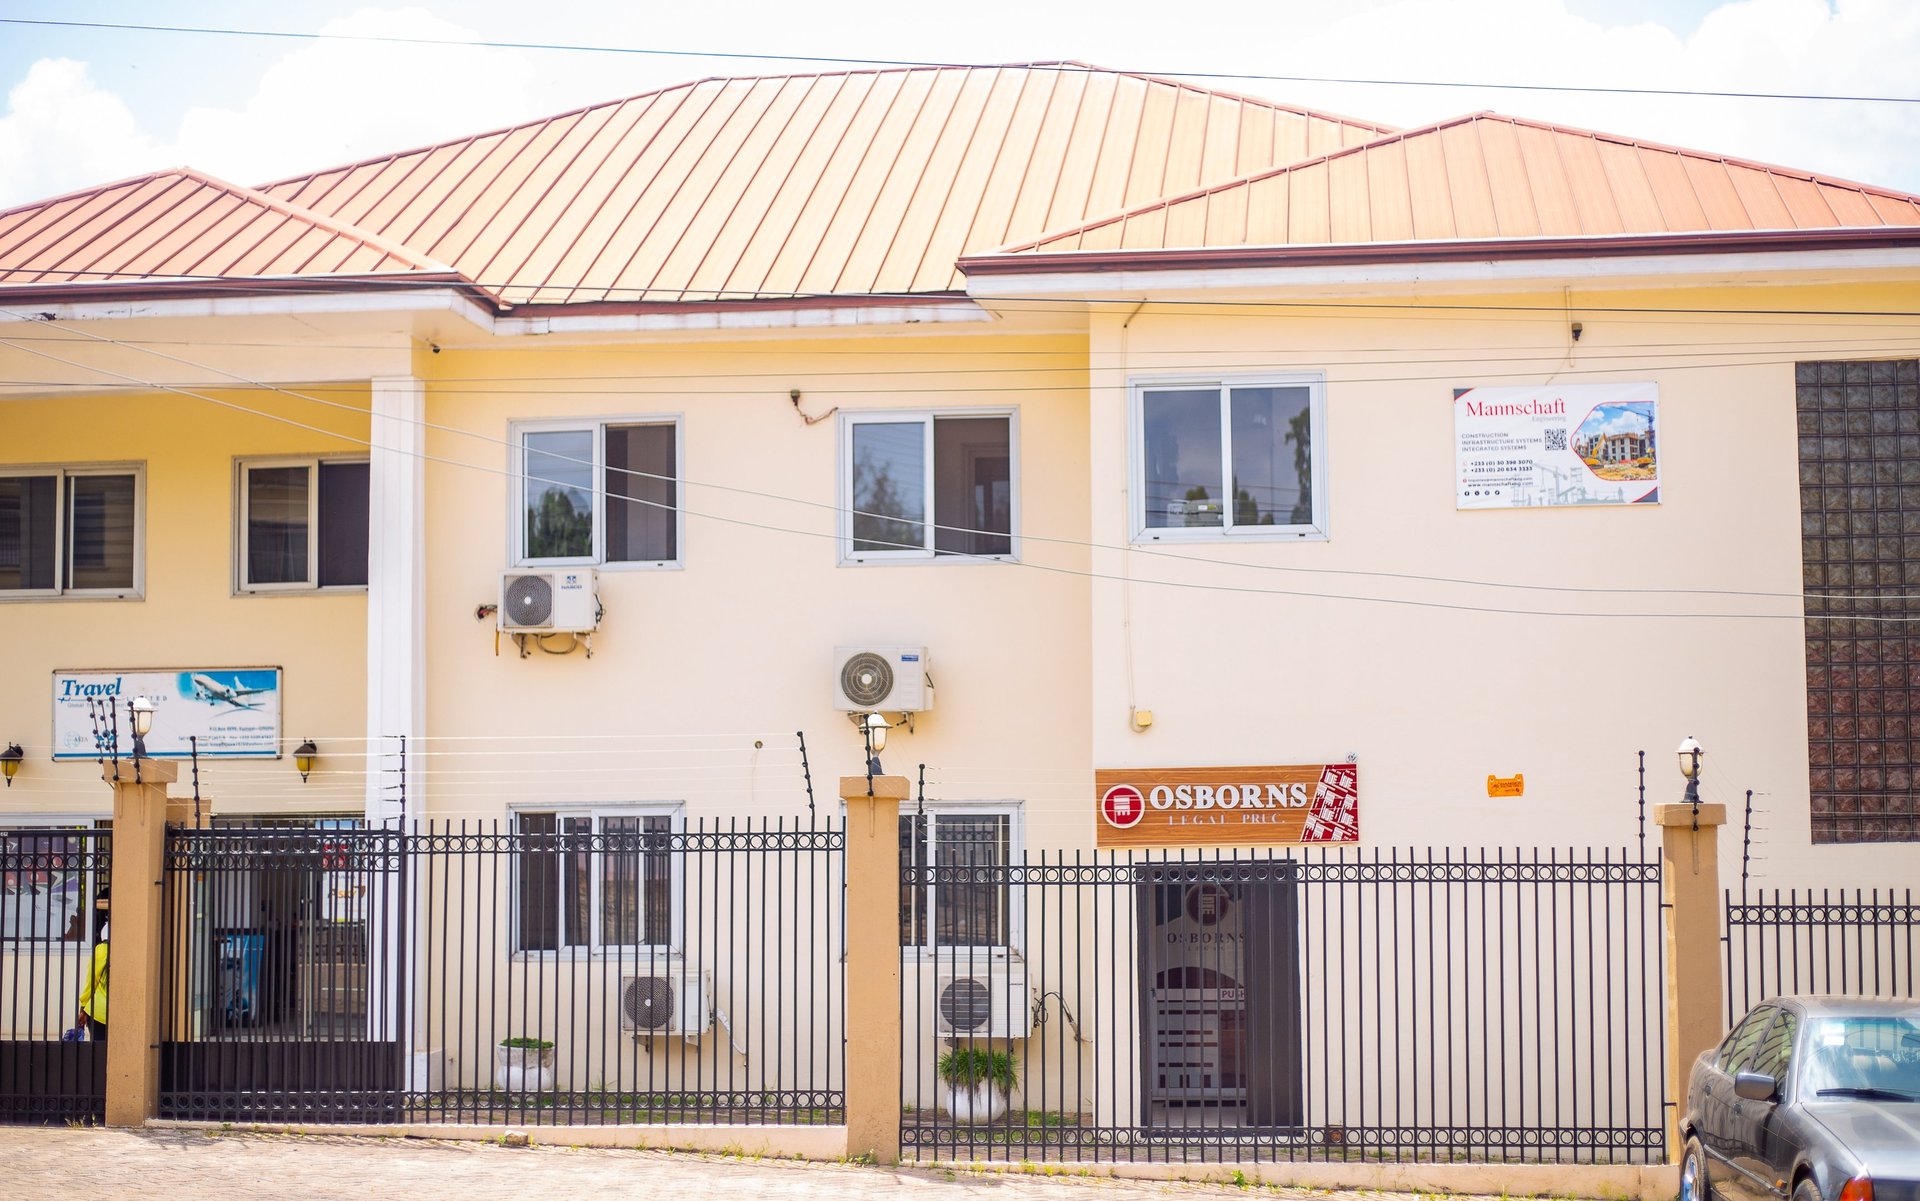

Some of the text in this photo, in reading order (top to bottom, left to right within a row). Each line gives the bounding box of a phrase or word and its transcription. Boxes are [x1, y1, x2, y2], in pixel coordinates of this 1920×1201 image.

[1466, 398, 1565, 417] Mannschaft
[61, 676, 122, 696] Travel
[1149, 783, 1308, 810] OSBORNS
